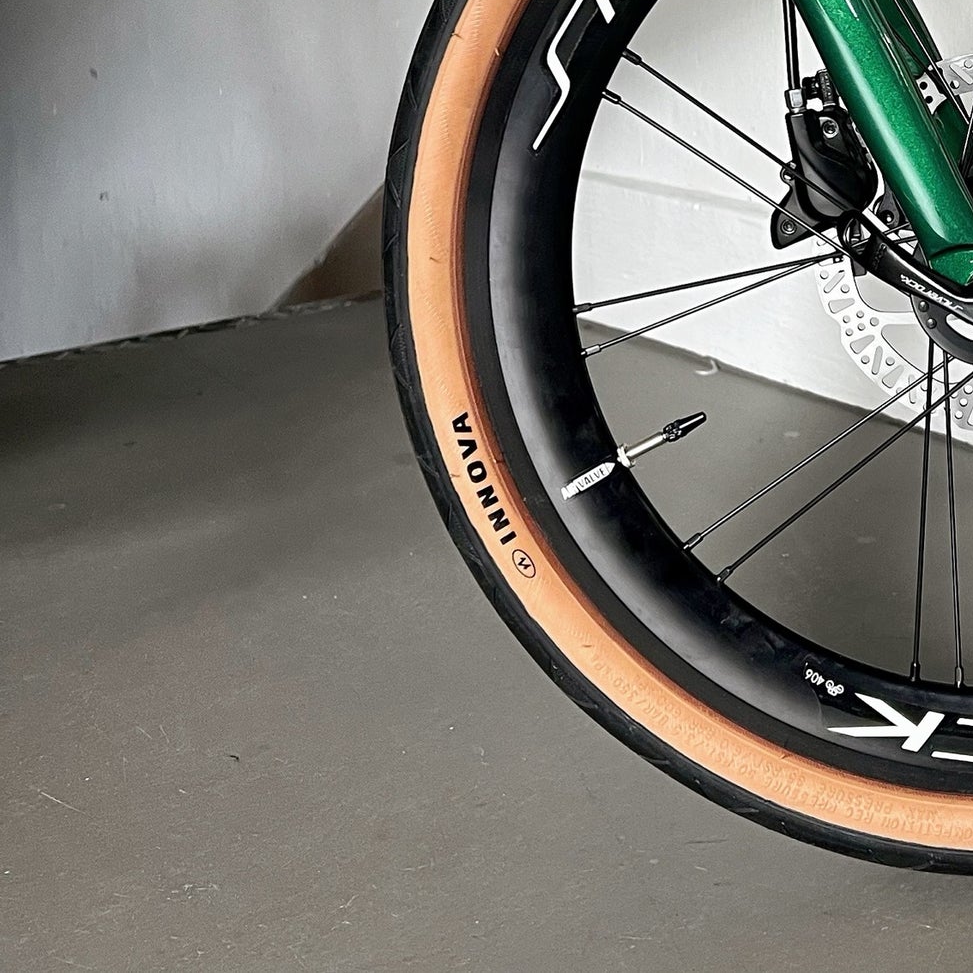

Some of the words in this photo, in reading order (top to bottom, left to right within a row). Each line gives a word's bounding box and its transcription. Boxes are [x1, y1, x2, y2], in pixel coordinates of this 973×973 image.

[450, 411, 519, 547] INNOVA
[577, 468, 607, 490] VALVE
[804, 669, 825, 686] 406
